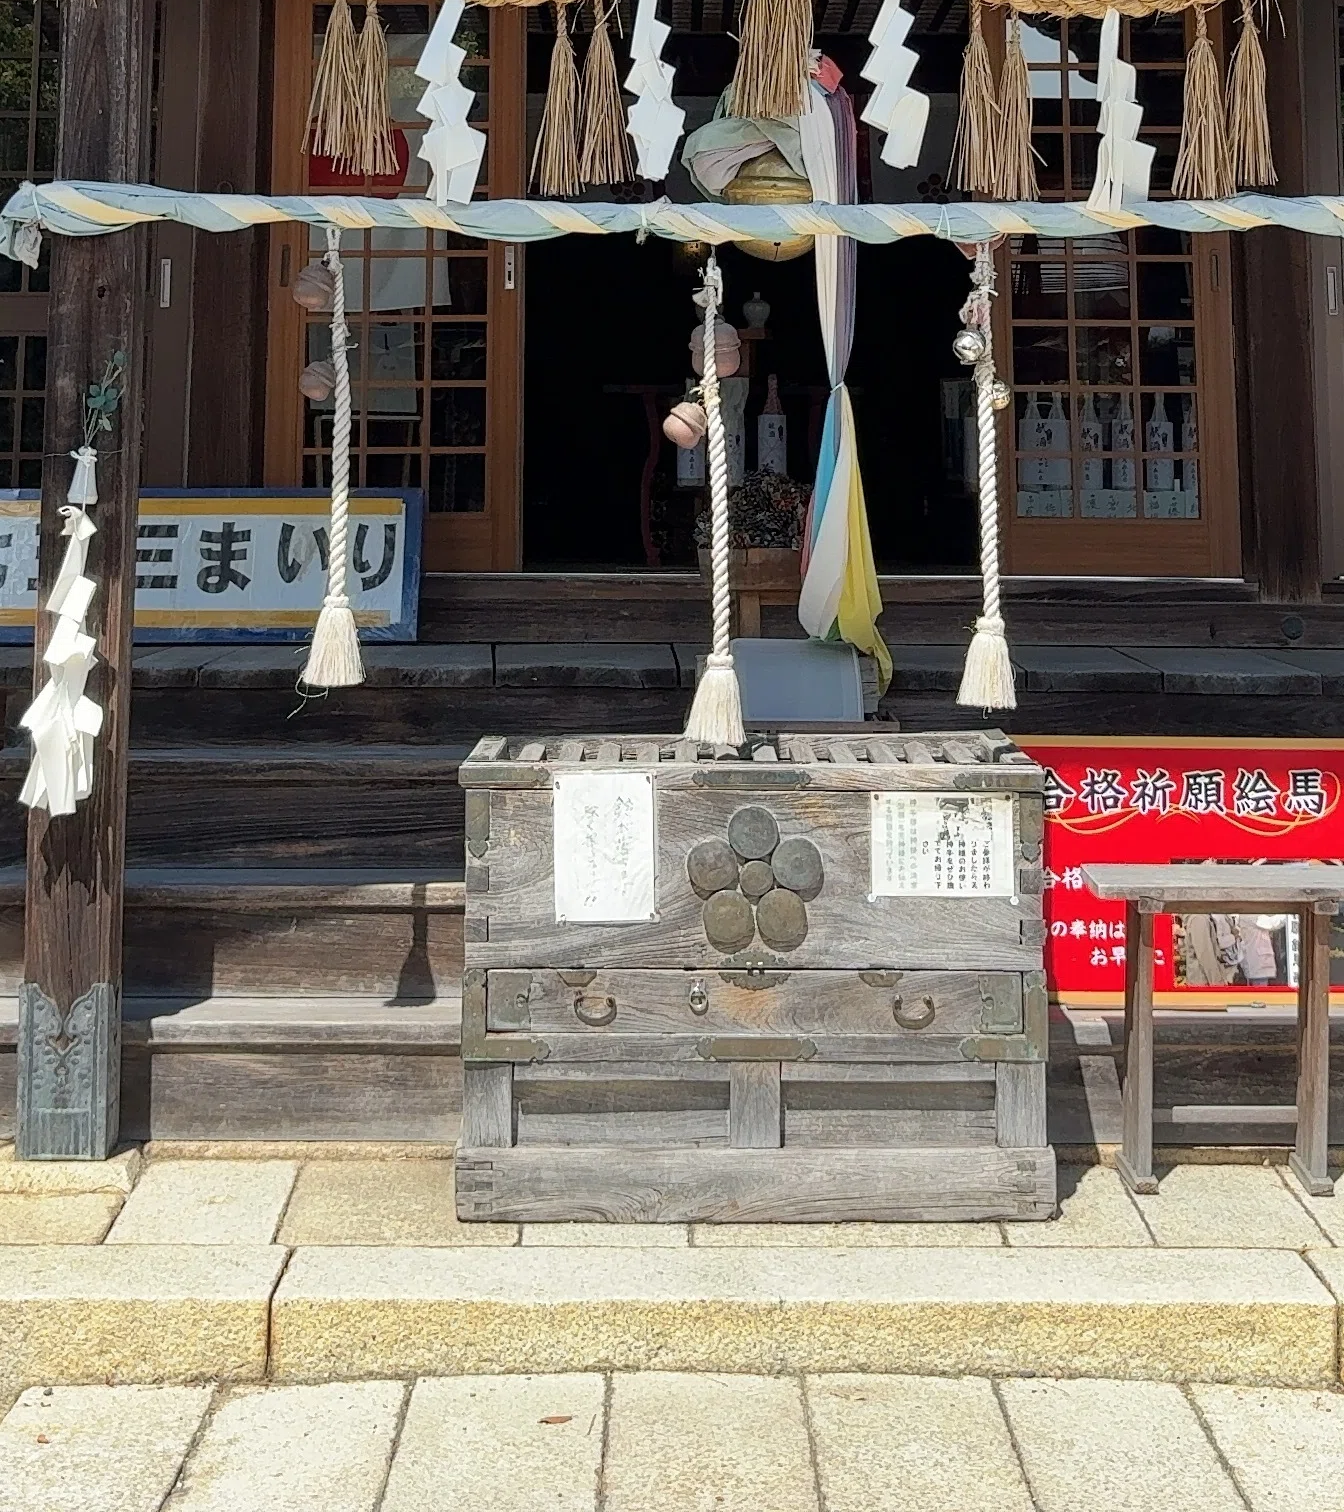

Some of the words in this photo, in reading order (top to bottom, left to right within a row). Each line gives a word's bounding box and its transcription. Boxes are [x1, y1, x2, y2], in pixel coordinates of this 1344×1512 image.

[1043, 766, 1328, 817] 合格祈願絵馬
